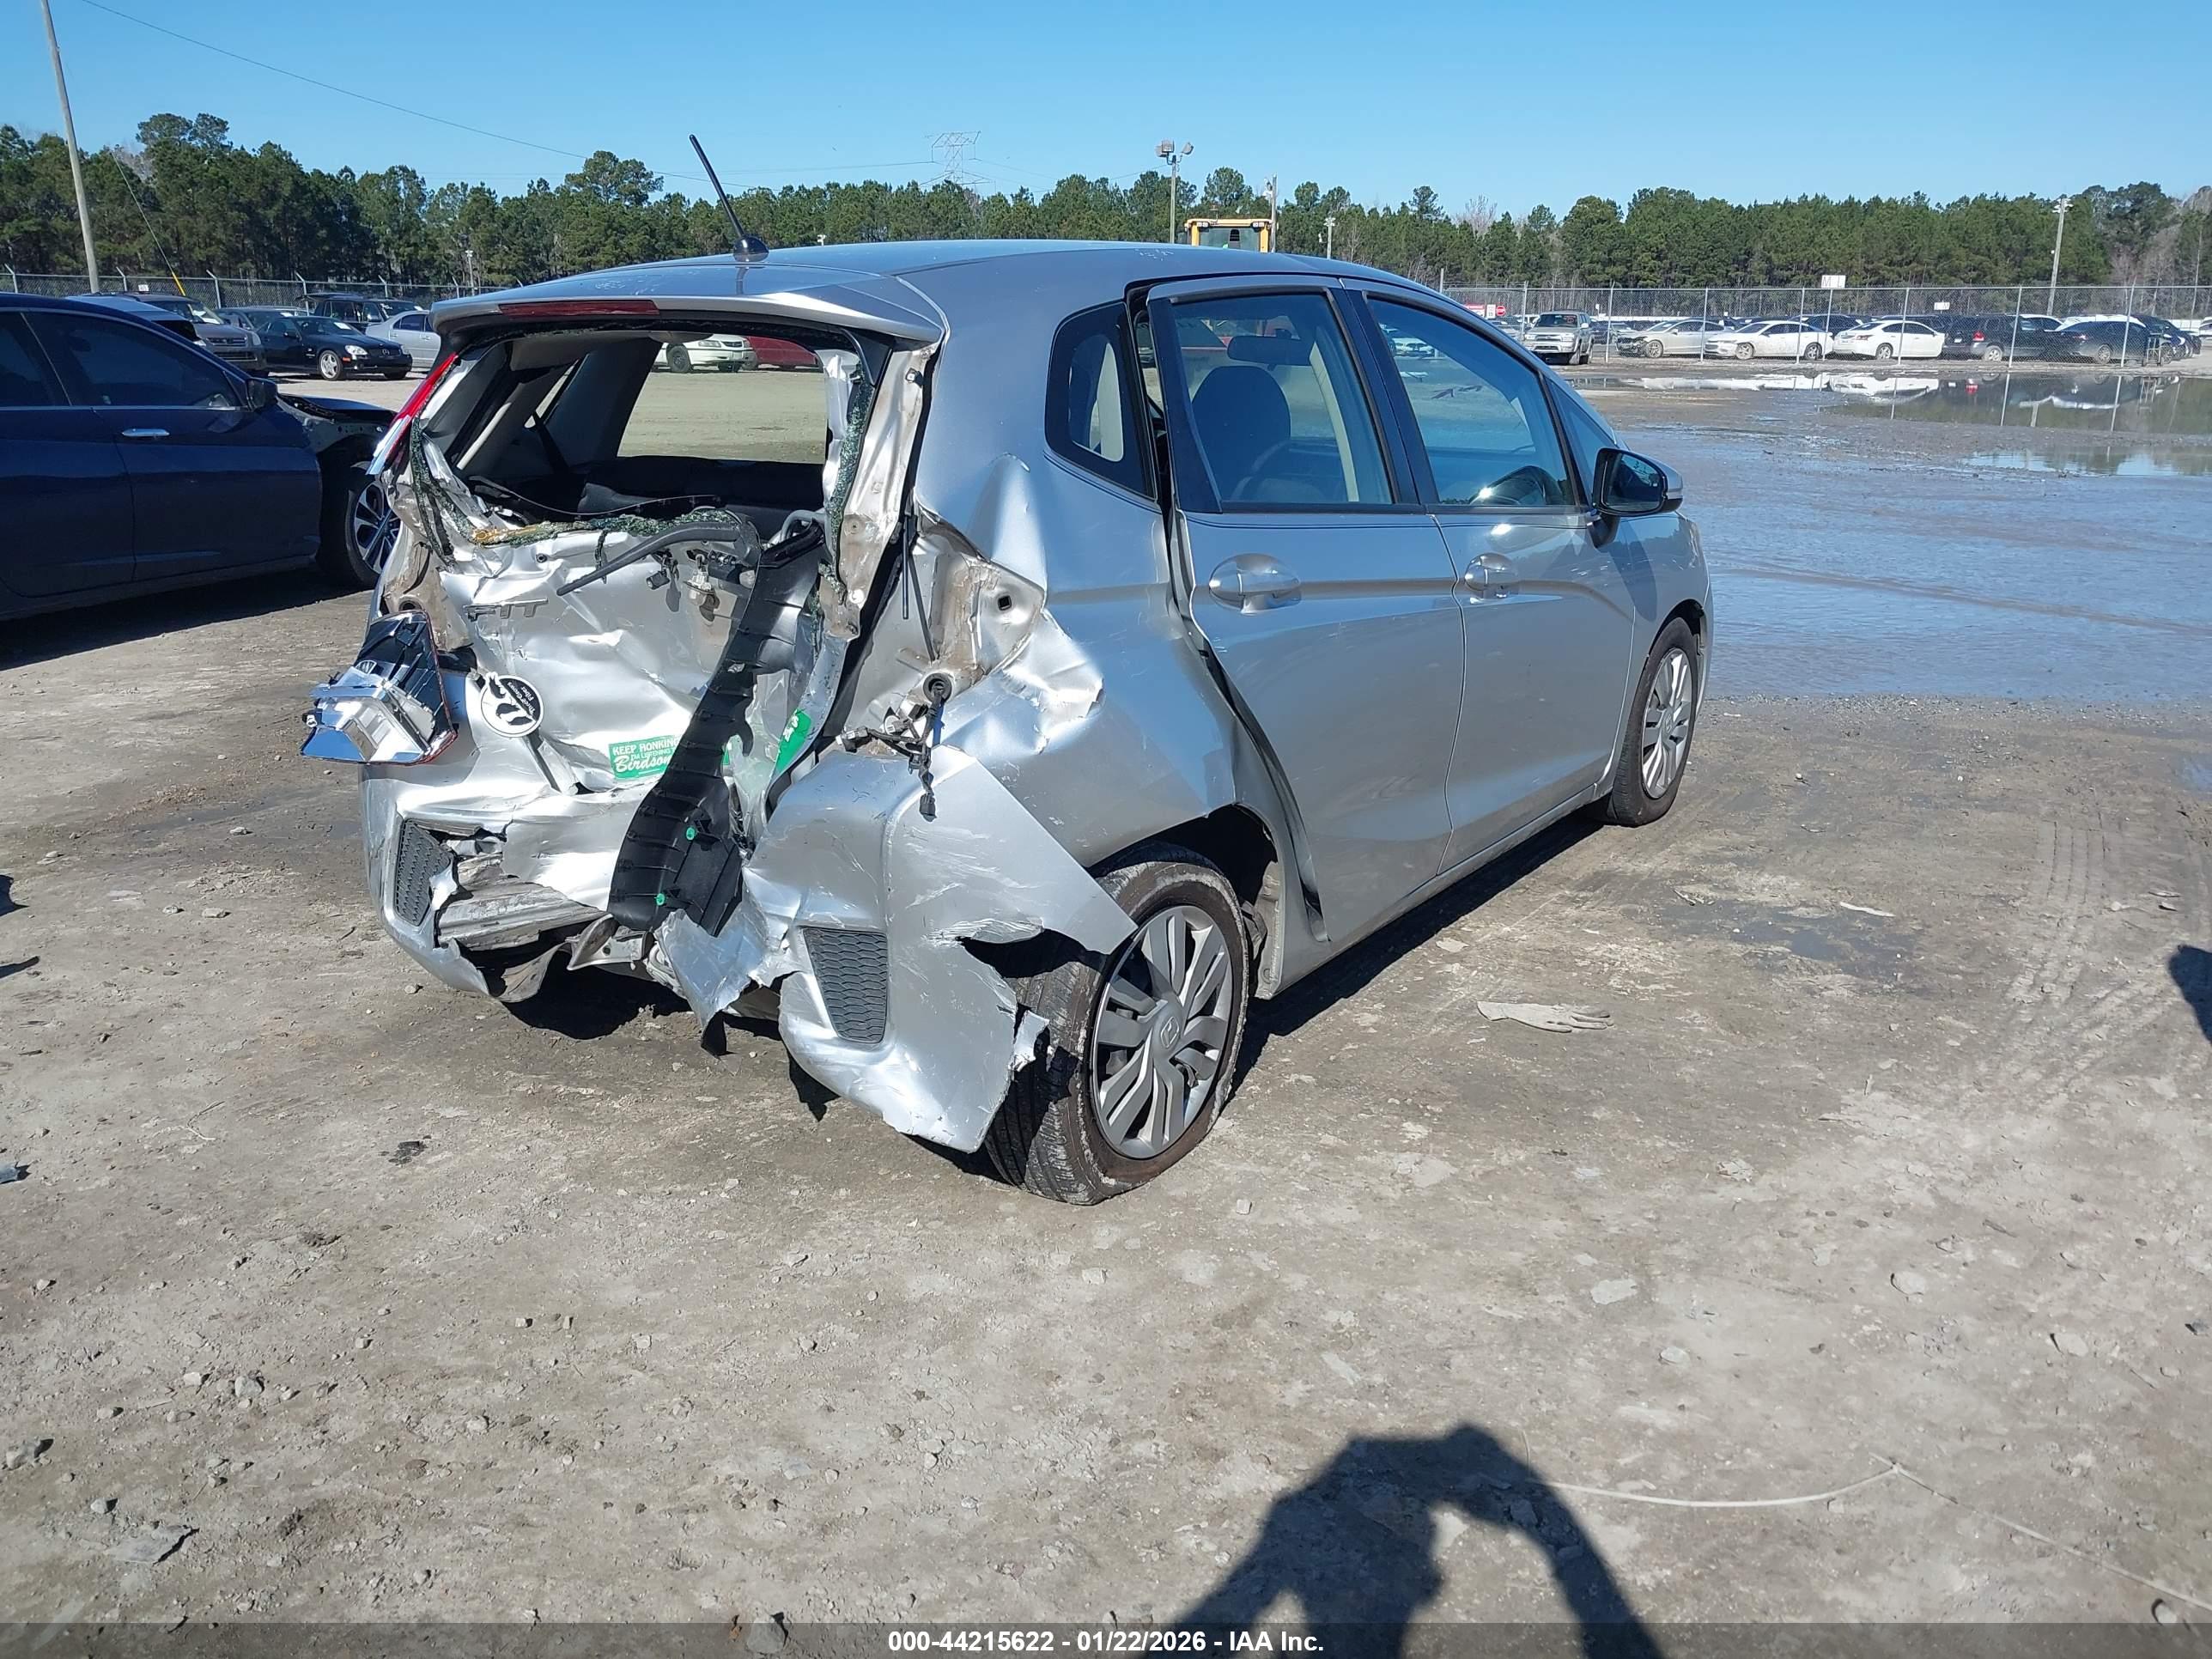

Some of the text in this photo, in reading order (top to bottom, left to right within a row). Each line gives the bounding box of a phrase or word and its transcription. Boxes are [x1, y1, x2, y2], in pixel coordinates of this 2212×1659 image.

[464, 599, 549, 622] FIT
[521, 686, 534, 702] Fiber
[521, 699, 536, 716] Three
[612, 744, 637, 756] KEEP
[614, 755, 672, 773] Birdson
